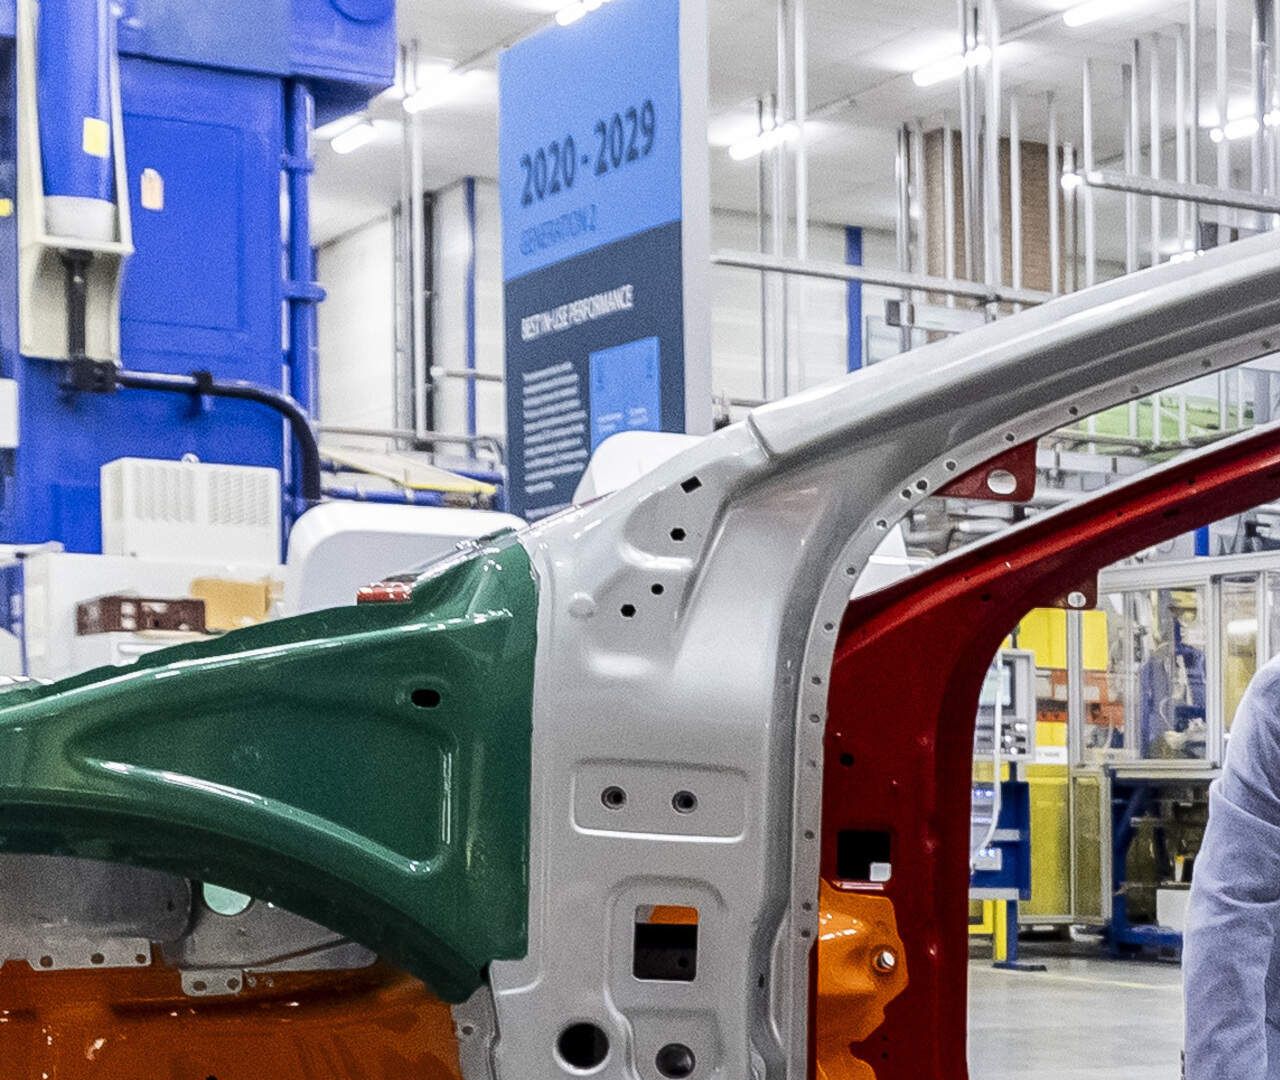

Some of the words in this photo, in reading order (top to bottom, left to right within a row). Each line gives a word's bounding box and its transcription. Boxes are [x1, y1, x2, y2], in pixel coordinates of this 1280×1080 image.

[521, 134, 575, 208] 2020
[594, 99, 655, 177] 2029
[568, 284, 634, 326] PERFORMANCE
